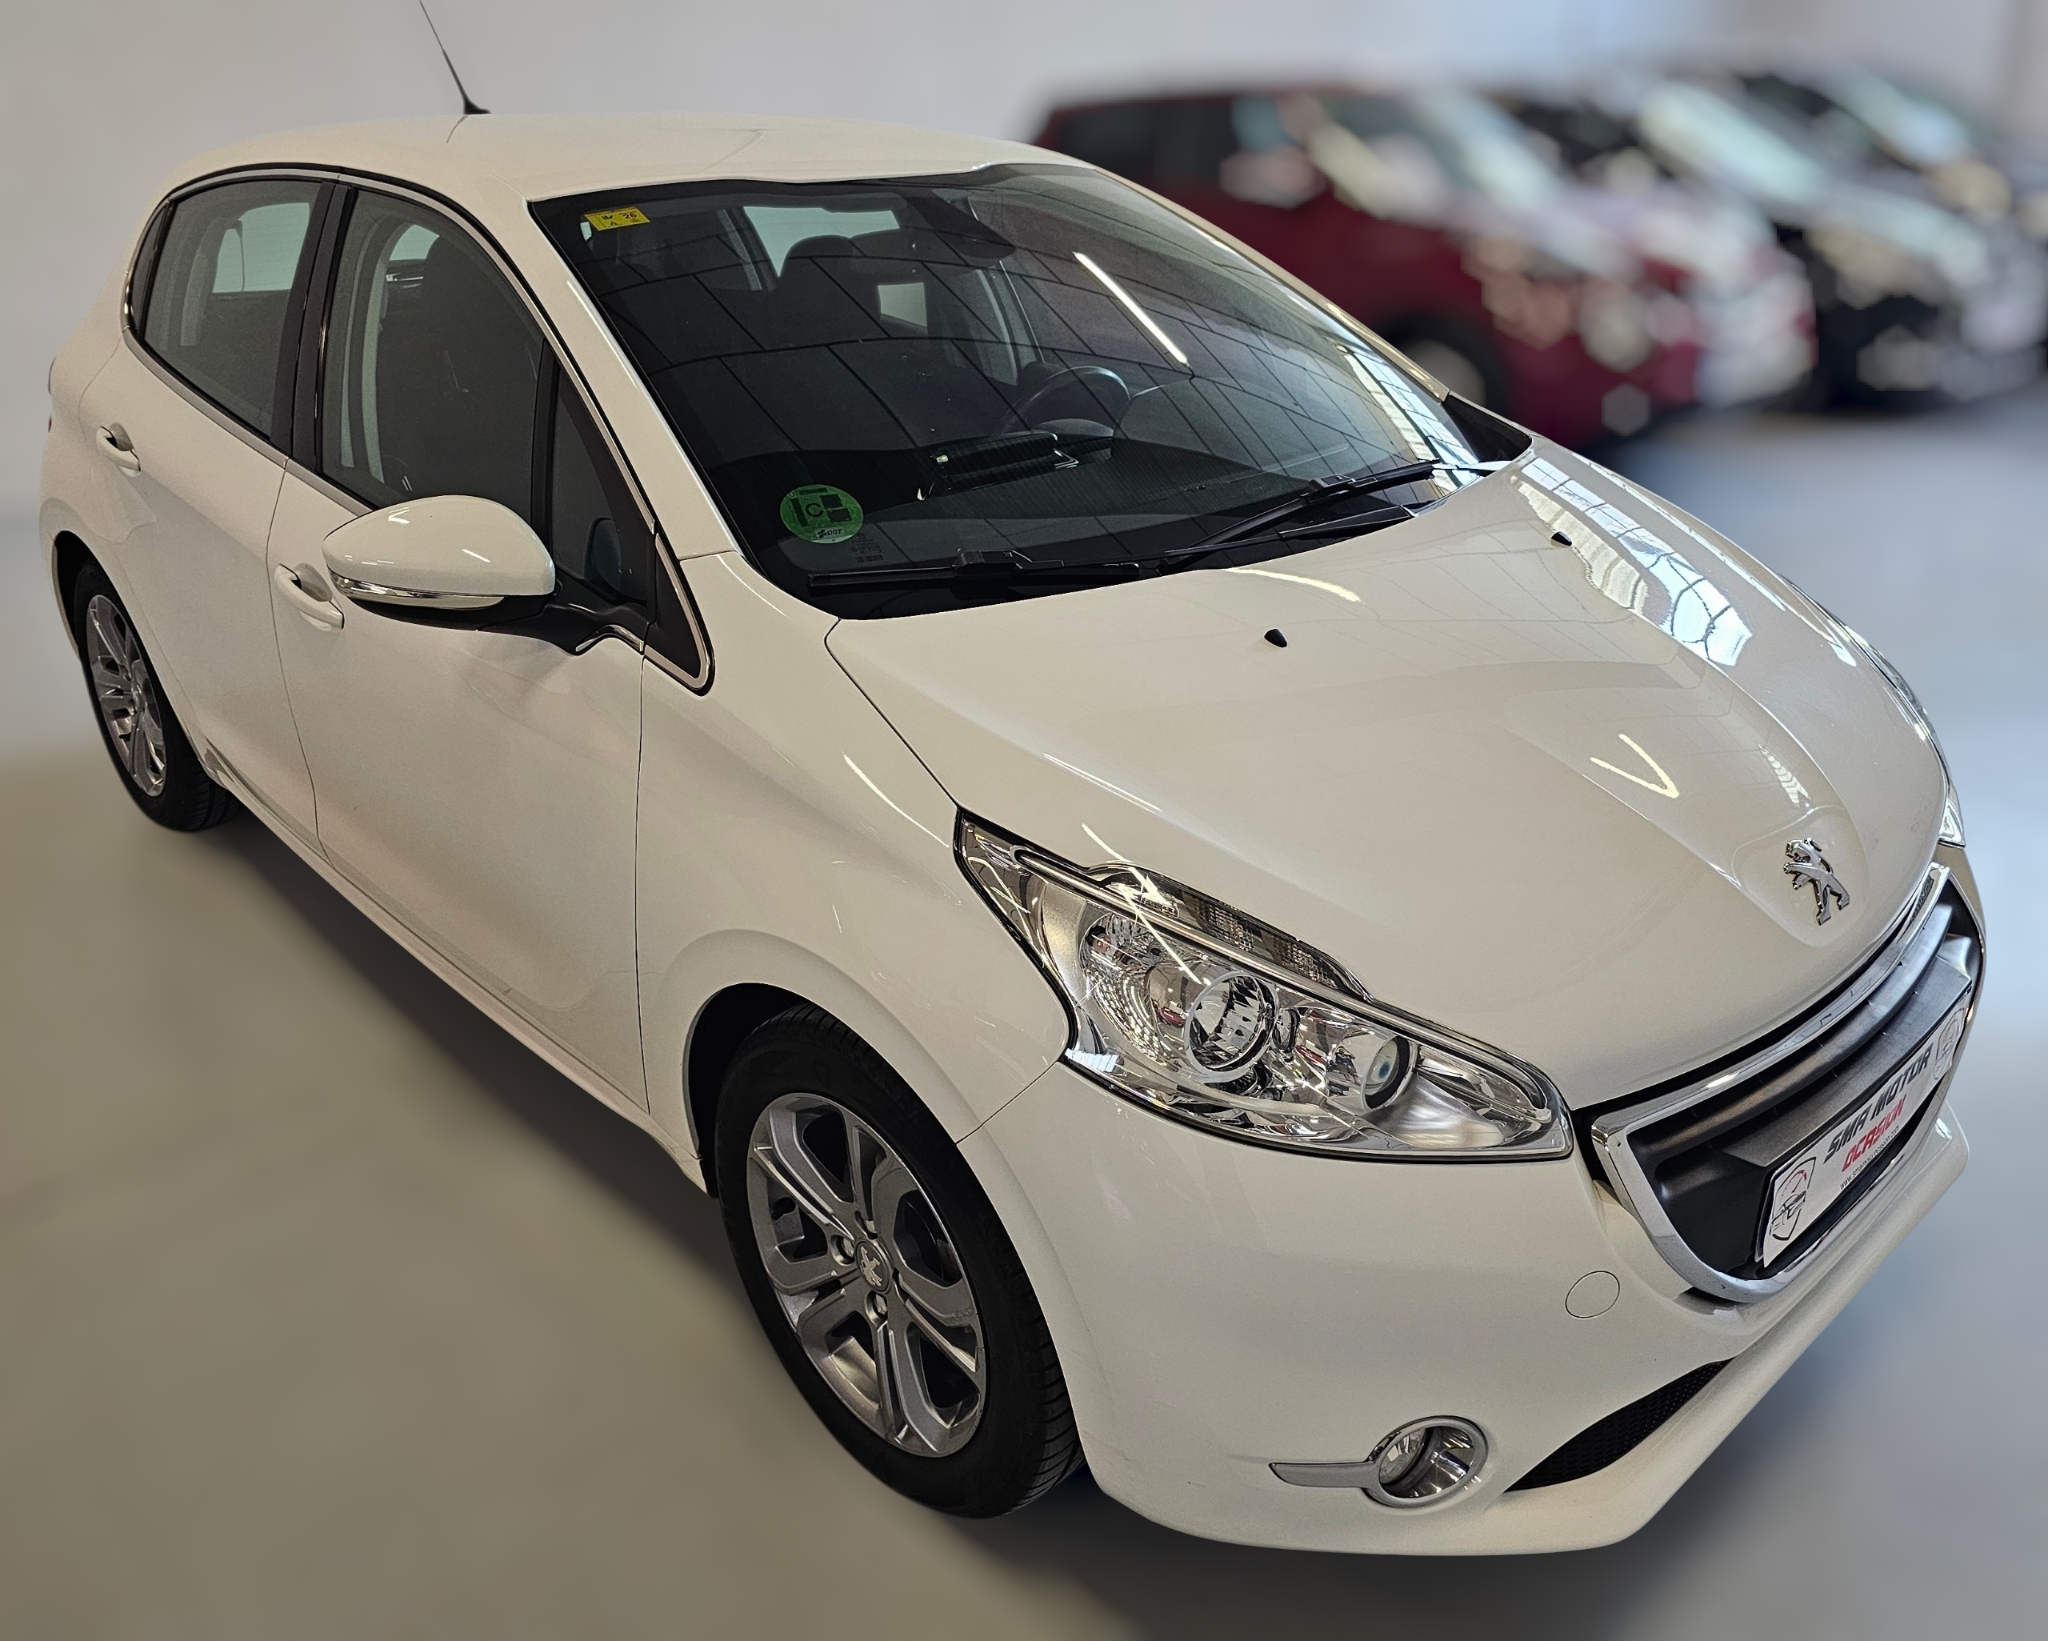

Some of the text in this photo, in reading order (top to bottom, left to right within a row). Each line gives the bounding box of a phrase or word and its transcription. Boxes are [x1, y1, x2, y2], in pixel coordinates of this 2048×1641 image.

[805, 502, 824, 517] C
[827, 528, 843, 536] DGT
[1823, 1042, 1933, 1164] SMA MOTOR
